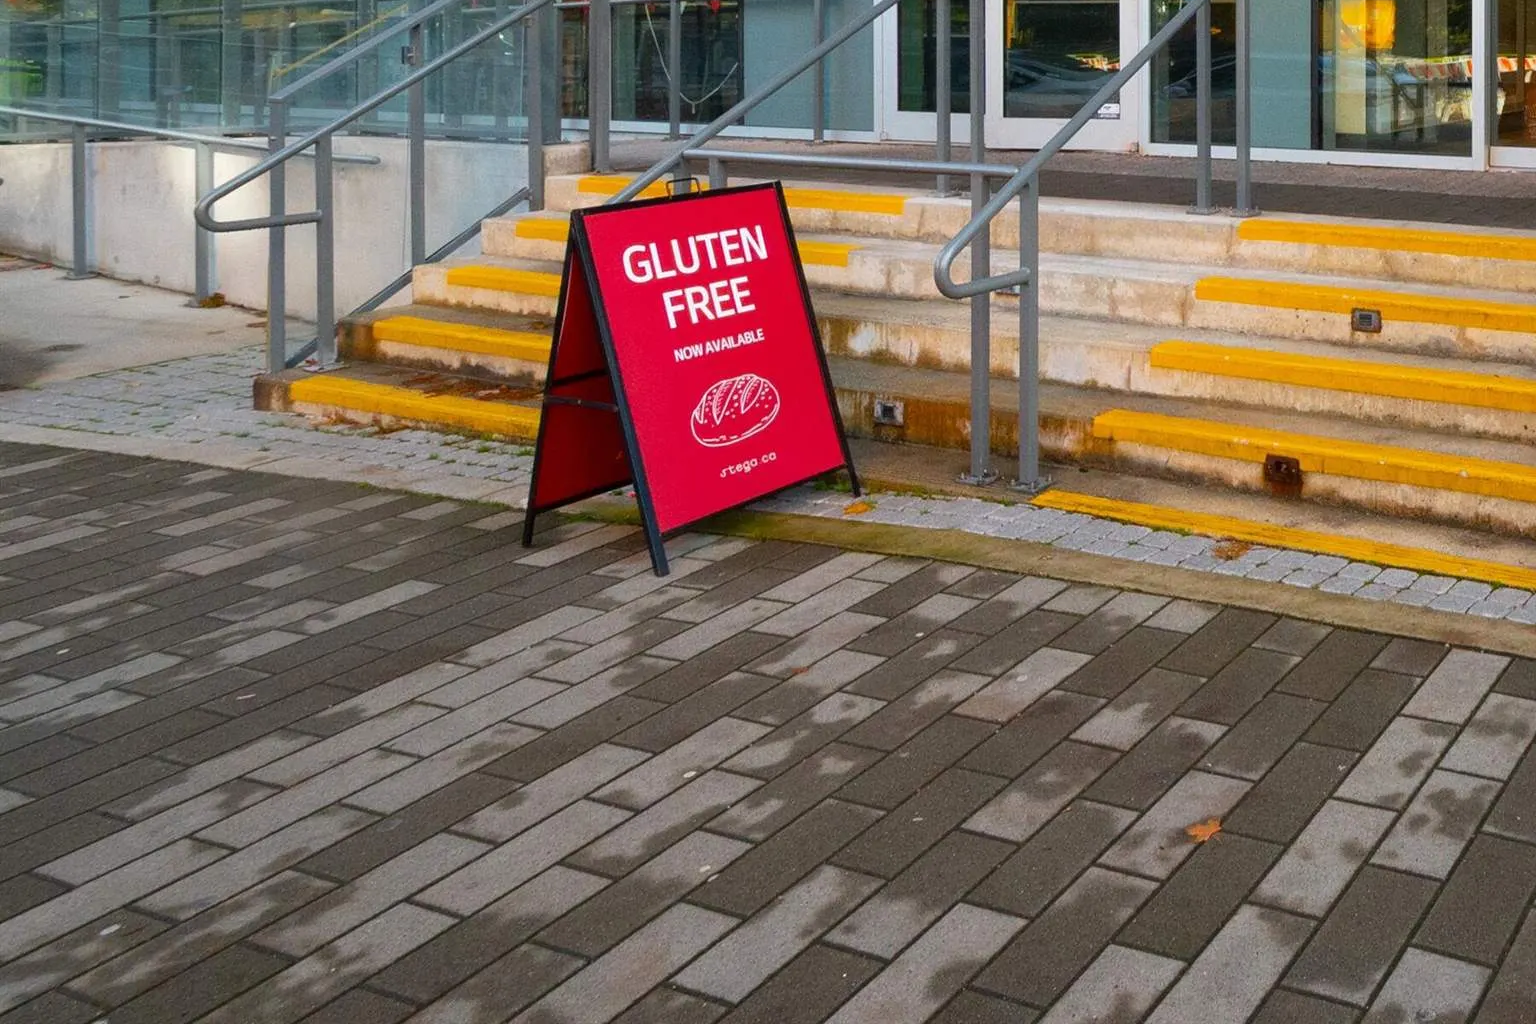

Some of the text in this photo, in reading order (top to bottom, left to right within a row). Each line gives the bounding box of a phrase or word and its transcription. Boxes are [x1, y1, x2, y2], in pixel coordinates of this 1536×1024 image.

[622, 224, 768, 284] GLUTEN
[662, 276, 756, 329] FREE
[674, 328, 765, 362] NOW AVAILABLE
